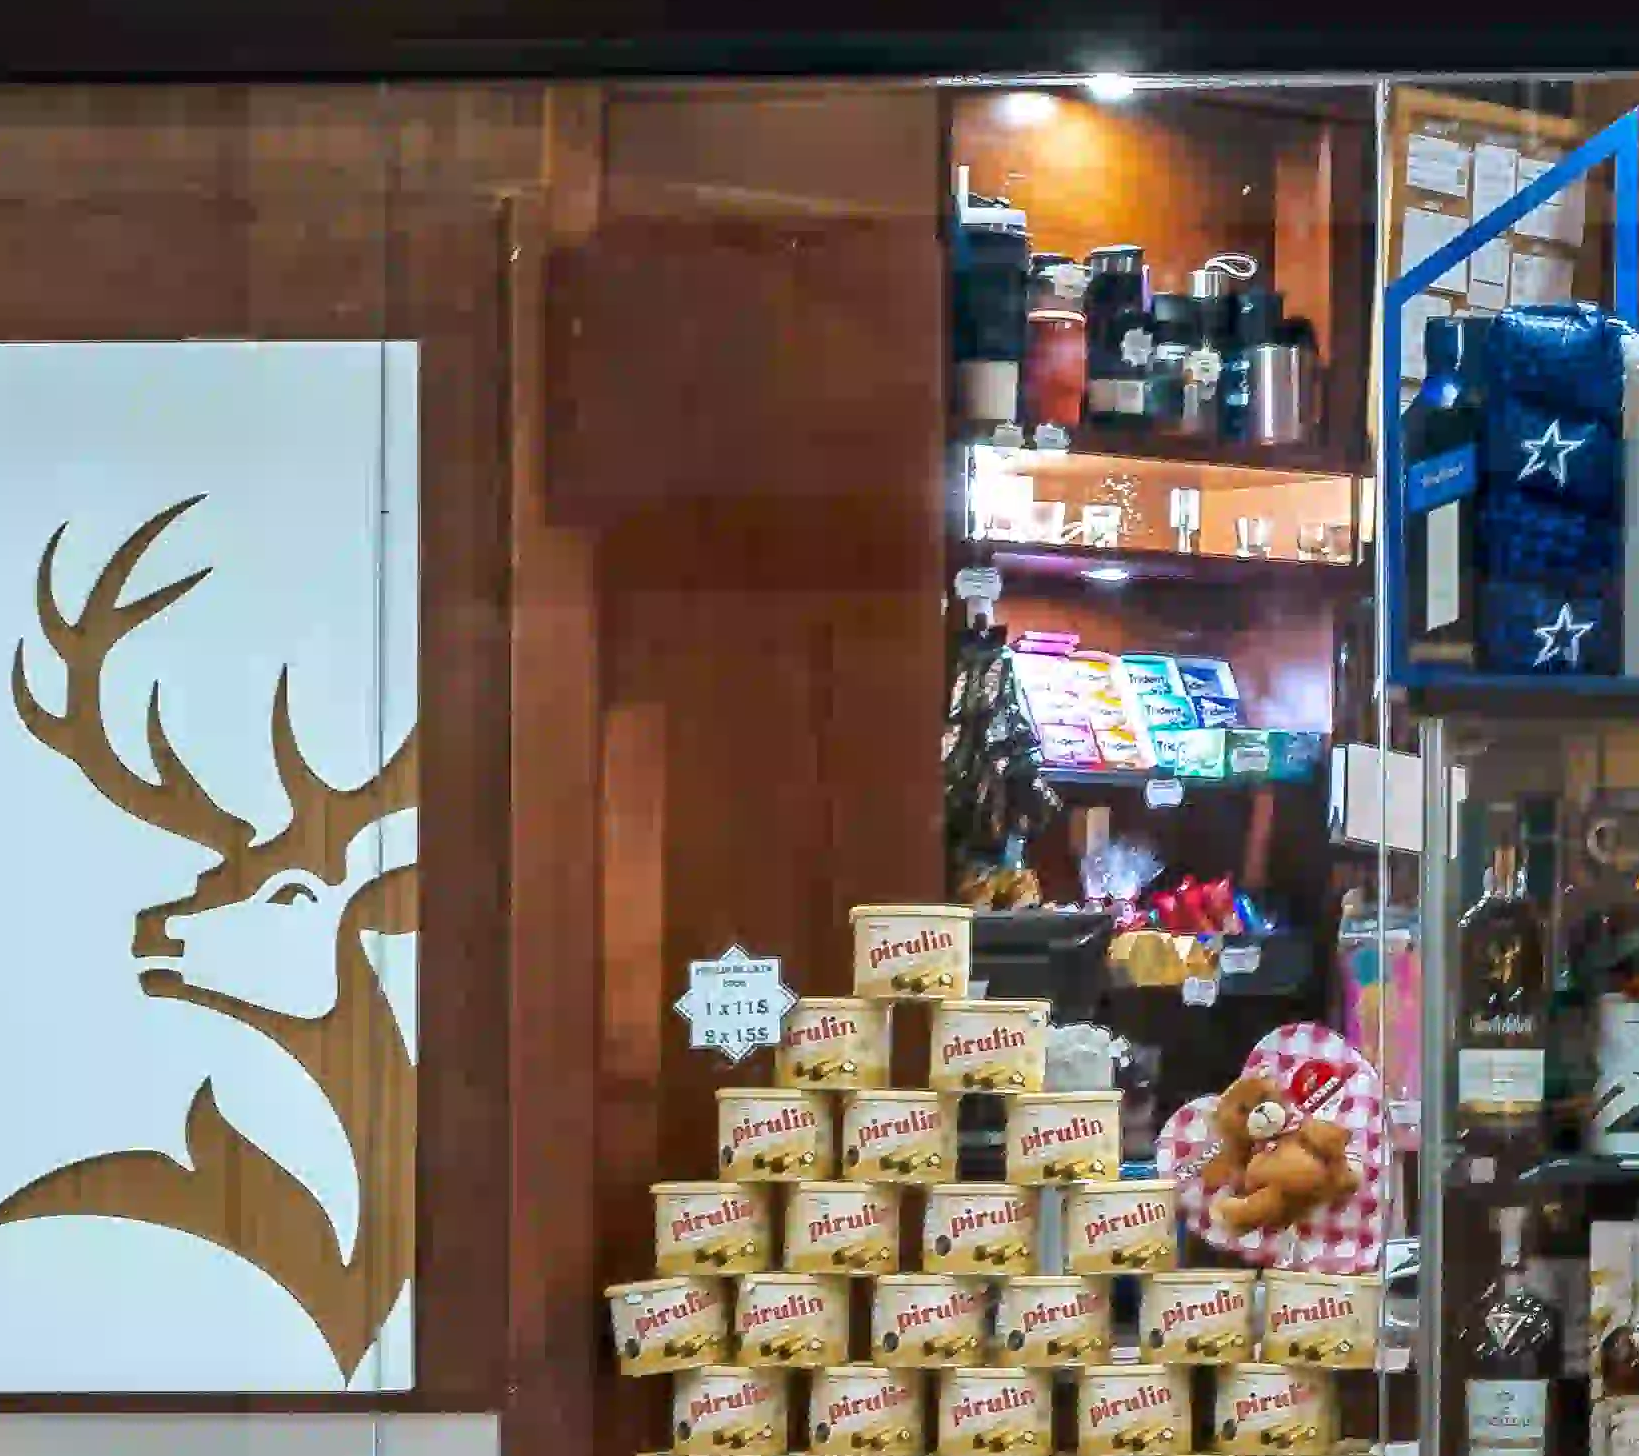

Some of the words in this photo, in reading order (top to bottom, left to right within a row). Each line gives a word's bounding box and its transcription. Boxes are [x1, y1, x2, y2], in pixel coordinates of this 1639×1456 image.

[1129, 673, 1167, 685] Trident
[1145, 705, 1183, 717] Trident
[869, 929, 953, 967] pirulin
[787, 1016, 858, 1049] irulin
[943, 1027, 1025, 1060] pirulin
[731, 1108, 817, 1147] pirulin
[858, 1108, 943, 1147] pirulin
[1020, 1118, 1103, 1153] pirulin
[1085, 1202, 1170, 1241] pirulin
[739, 1293, 825, 1331] pirulin
[1162, 1290, 1244, 1331] pirulin
[1270, 1294, 1354, 1330] pirulin
[950, 1386, 1036, 1427] pirulin
[1089, 1386, 1172, 1424] pirulin
